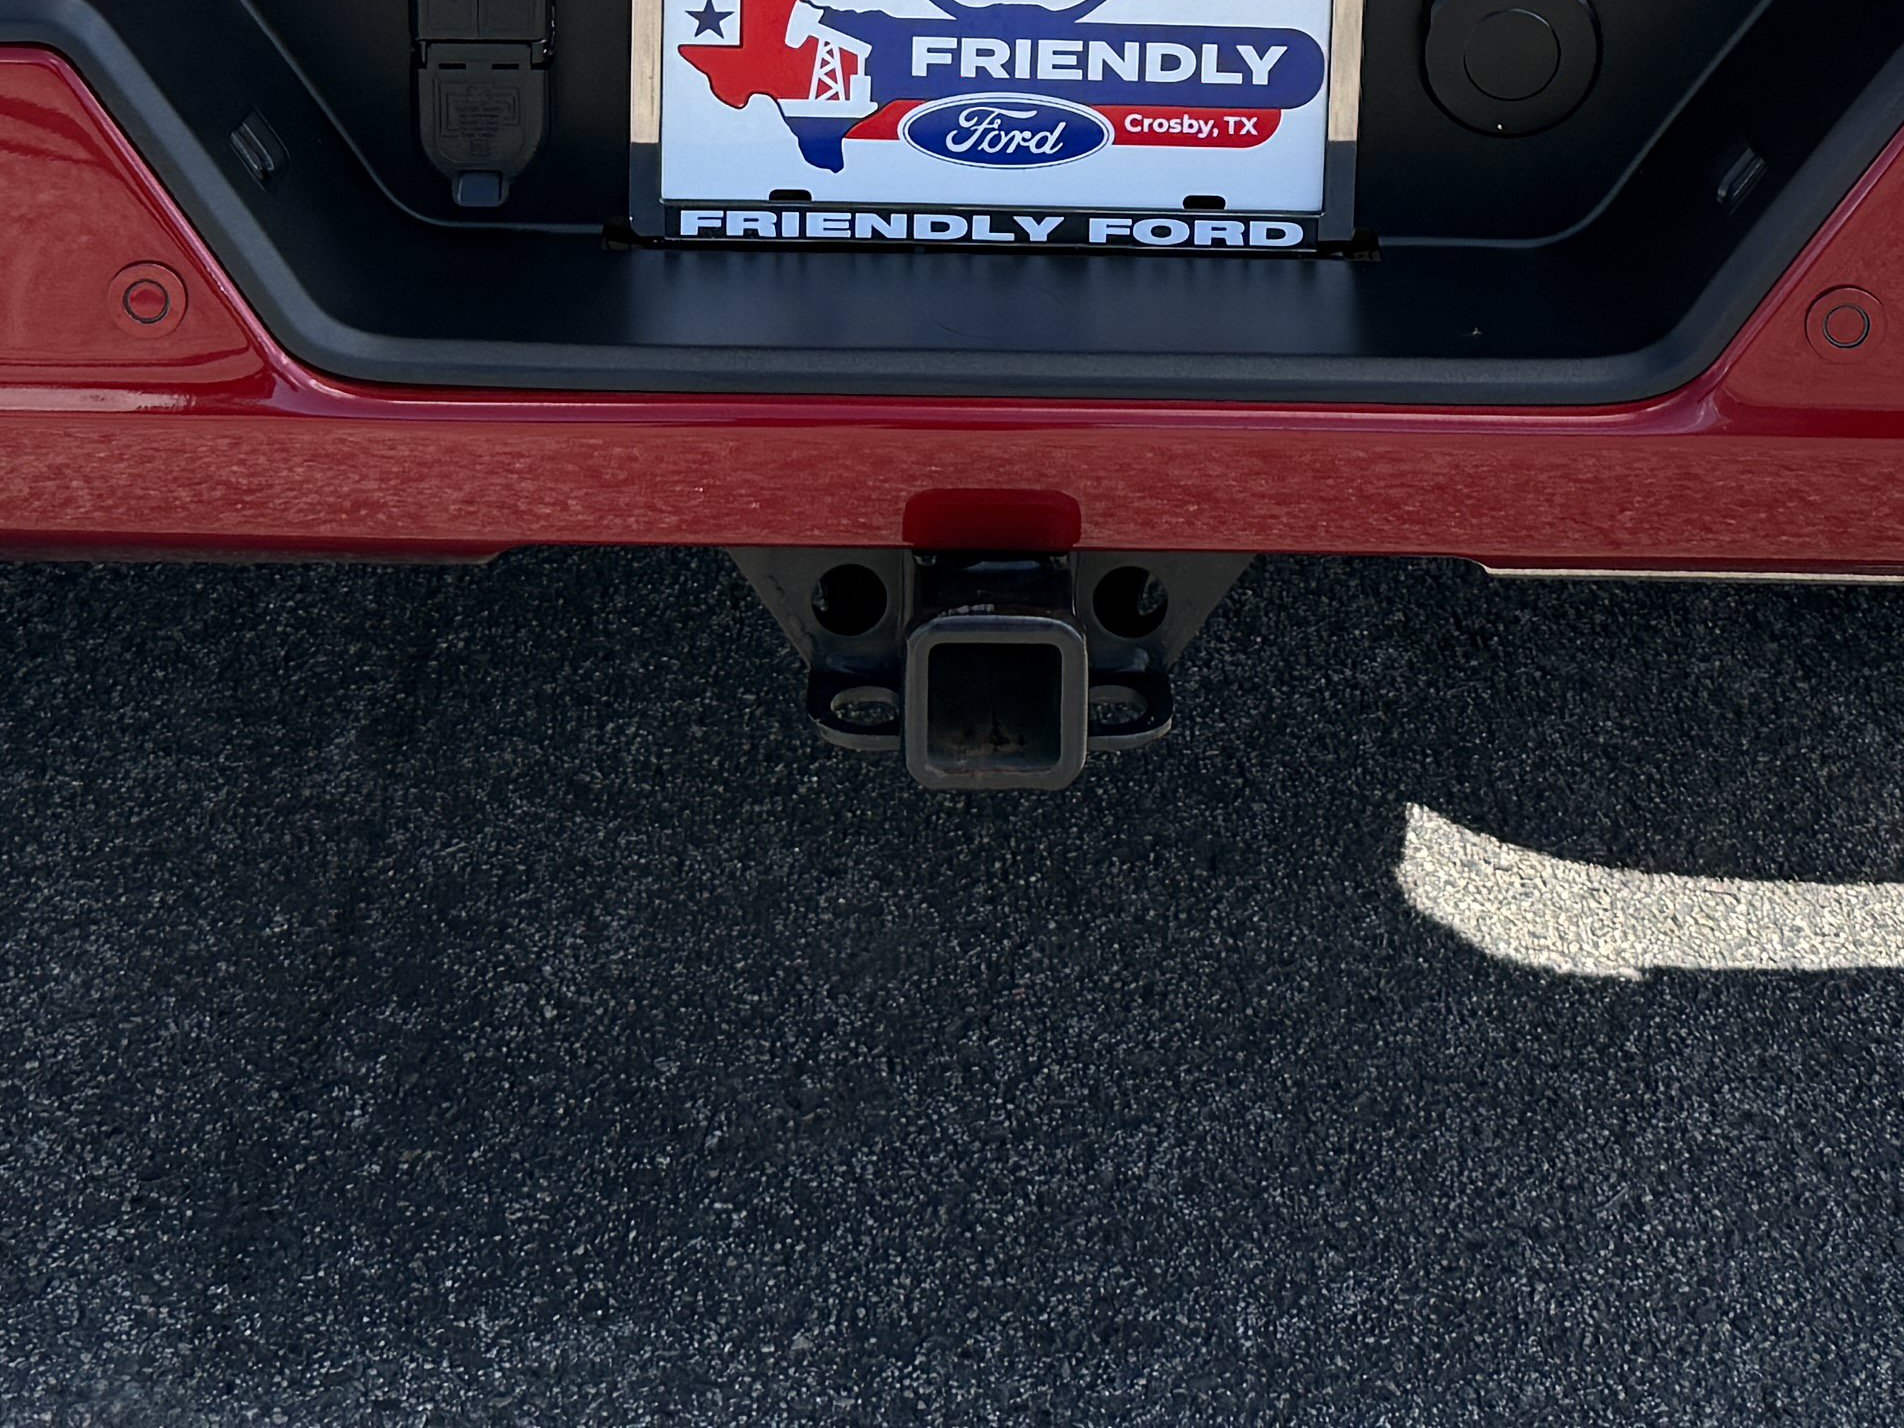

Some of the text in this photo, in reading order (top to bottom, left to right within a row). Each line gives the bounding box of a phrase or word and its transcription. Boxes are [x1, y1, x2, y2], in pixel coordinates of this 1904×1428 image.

[911, 36, 1288, 85] FRIENDLY
[945, 105, 1065, 155] Ford
[1124, 113, 1258, 137] Crosby, TX
[679, 210, 1305, 247] FRIENDLY FORD
